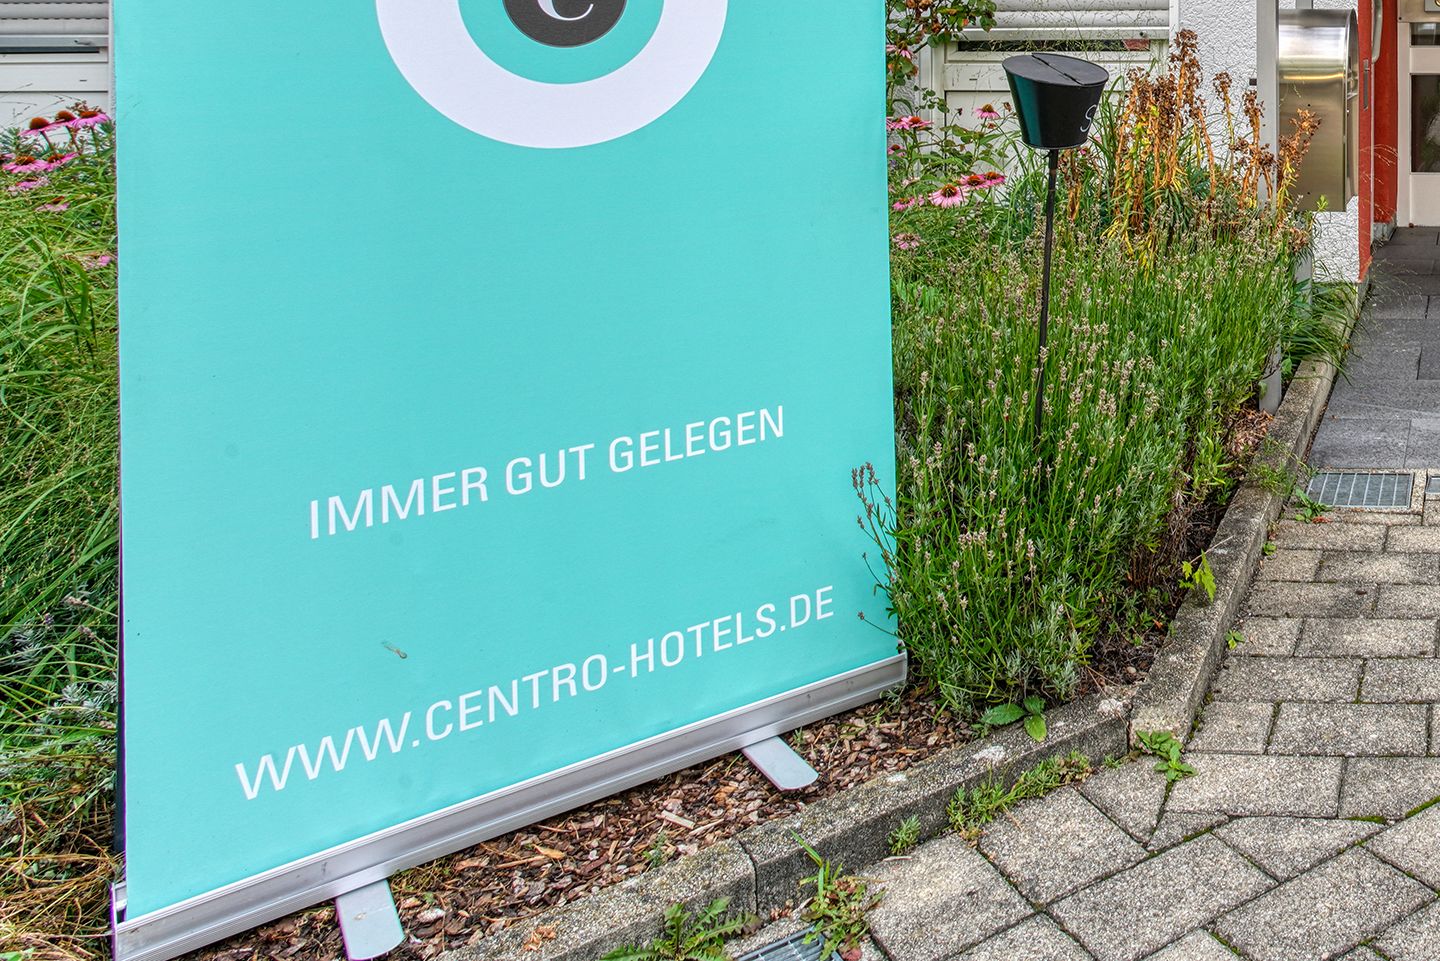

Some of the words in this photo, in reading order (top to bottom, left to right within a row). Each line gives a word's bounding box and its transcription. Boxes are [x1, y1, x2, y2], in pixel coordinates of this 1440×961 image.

[310, 466, 489, 540] IMMER
[505, 442, 595, 496] GUT
[608, 405, 785, 473] GELEGEN
[234, 585, 834, 800] WWW.CENTRO-HOTELS.DE
